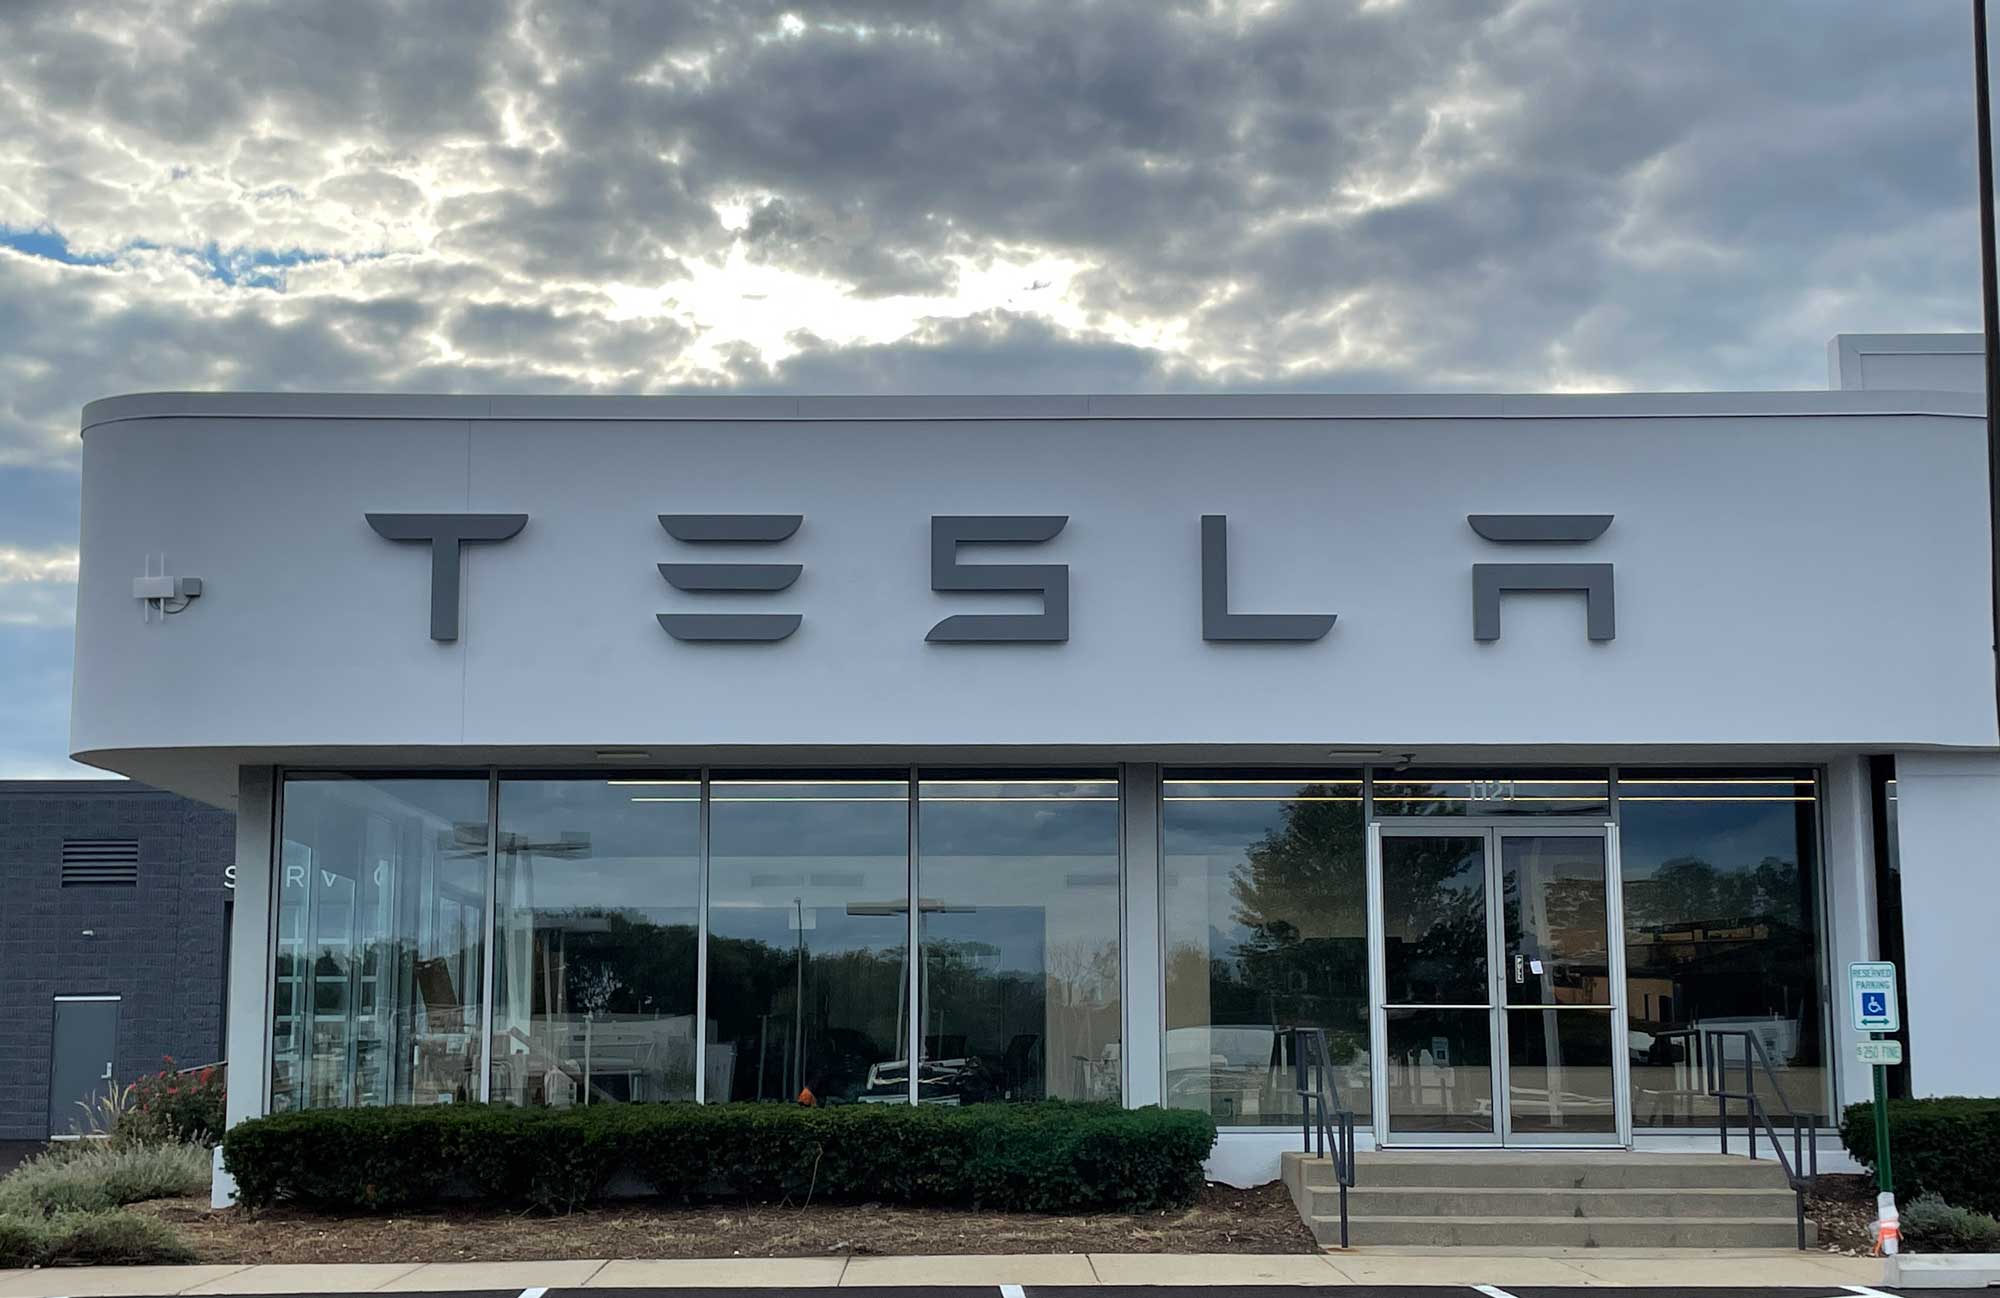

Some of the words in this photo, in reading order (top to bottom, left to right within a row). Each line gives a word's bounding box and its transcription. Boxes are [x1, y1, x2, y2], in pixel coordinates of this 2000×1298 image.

[364, 513, 1616, 646] TESLA
[1465, 780, 1515, 801] 1121
[1852, 969, 1892, 978] RESERVED
[1856, 981, 1891, 989] PARKING
